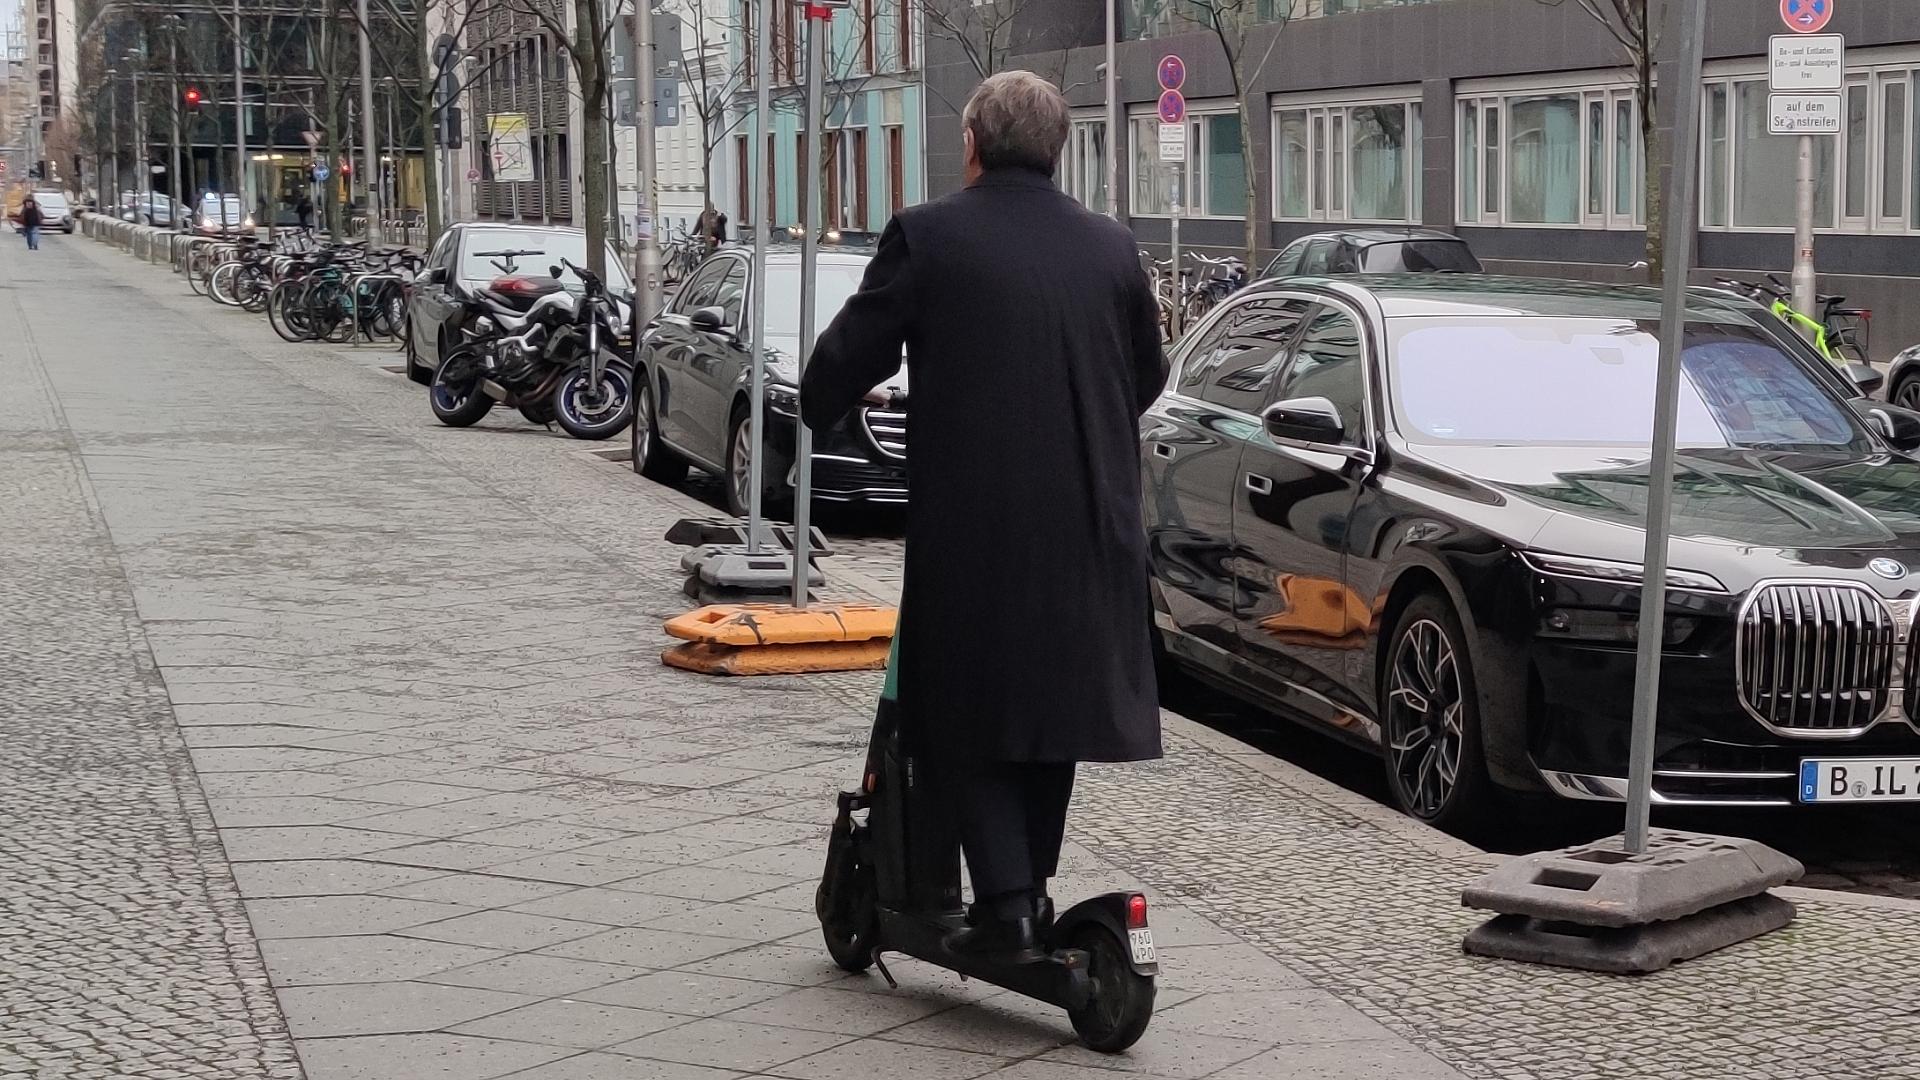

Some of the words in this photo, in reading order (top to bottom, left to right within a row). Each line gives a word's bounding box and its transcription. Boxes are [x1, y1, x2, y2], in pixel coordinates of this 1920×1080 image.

[1786, 101, 1801, 112] auf
[1805, 100, 1825, 112] dem
[1774, 115, 1837, 127] Senstreifen
[1830, 766, 1849, 796] B
[1805, 785, 1813, 794] D
